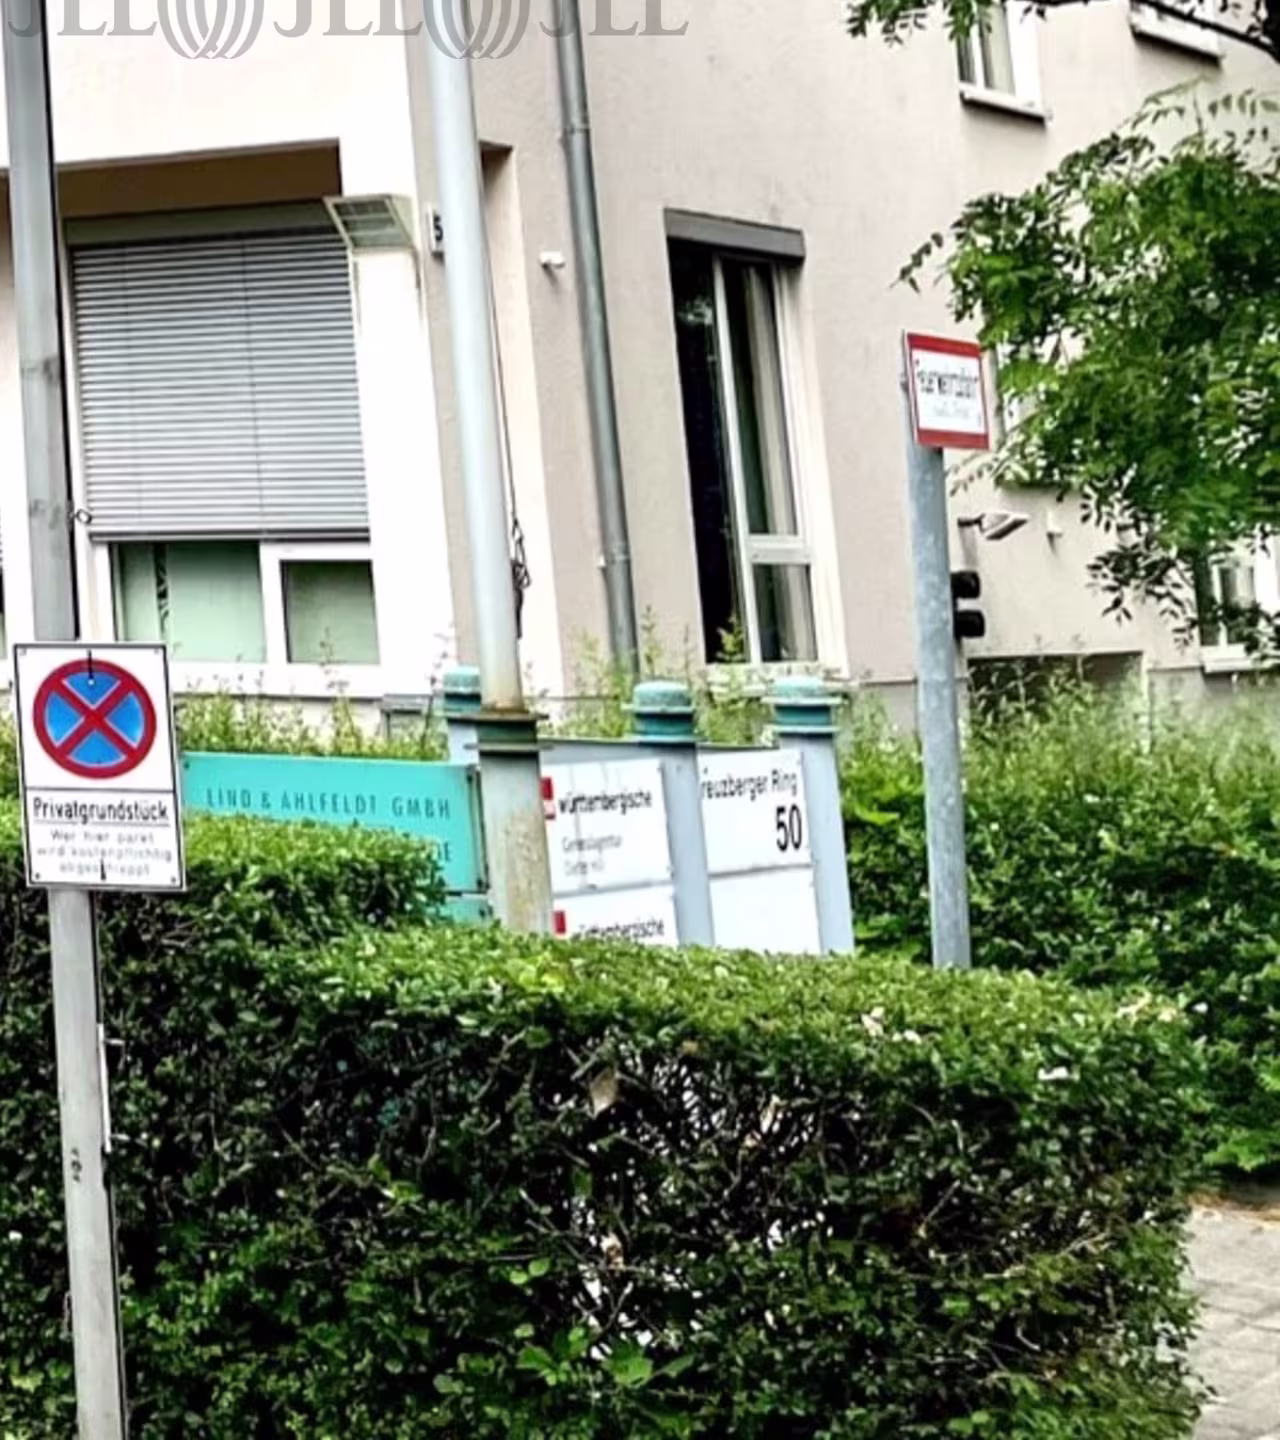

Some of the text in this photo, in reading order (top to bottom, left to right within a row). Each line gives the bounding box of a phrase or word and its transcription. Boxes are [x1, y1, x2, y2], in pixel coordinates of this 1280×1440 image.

[701, 769, 798, 802] reuzberger Ring
[32, 795, 170, 825] Privatgrundstück
[206, 788, 451, 820] LIND & AHLFELDT GMBH
[50, 828, 75, 842] Wer
[83, 831, 109, 842] hier
[775, 803, 803, 852] 50
[59, 862, 151, 877] abgeshleppt
